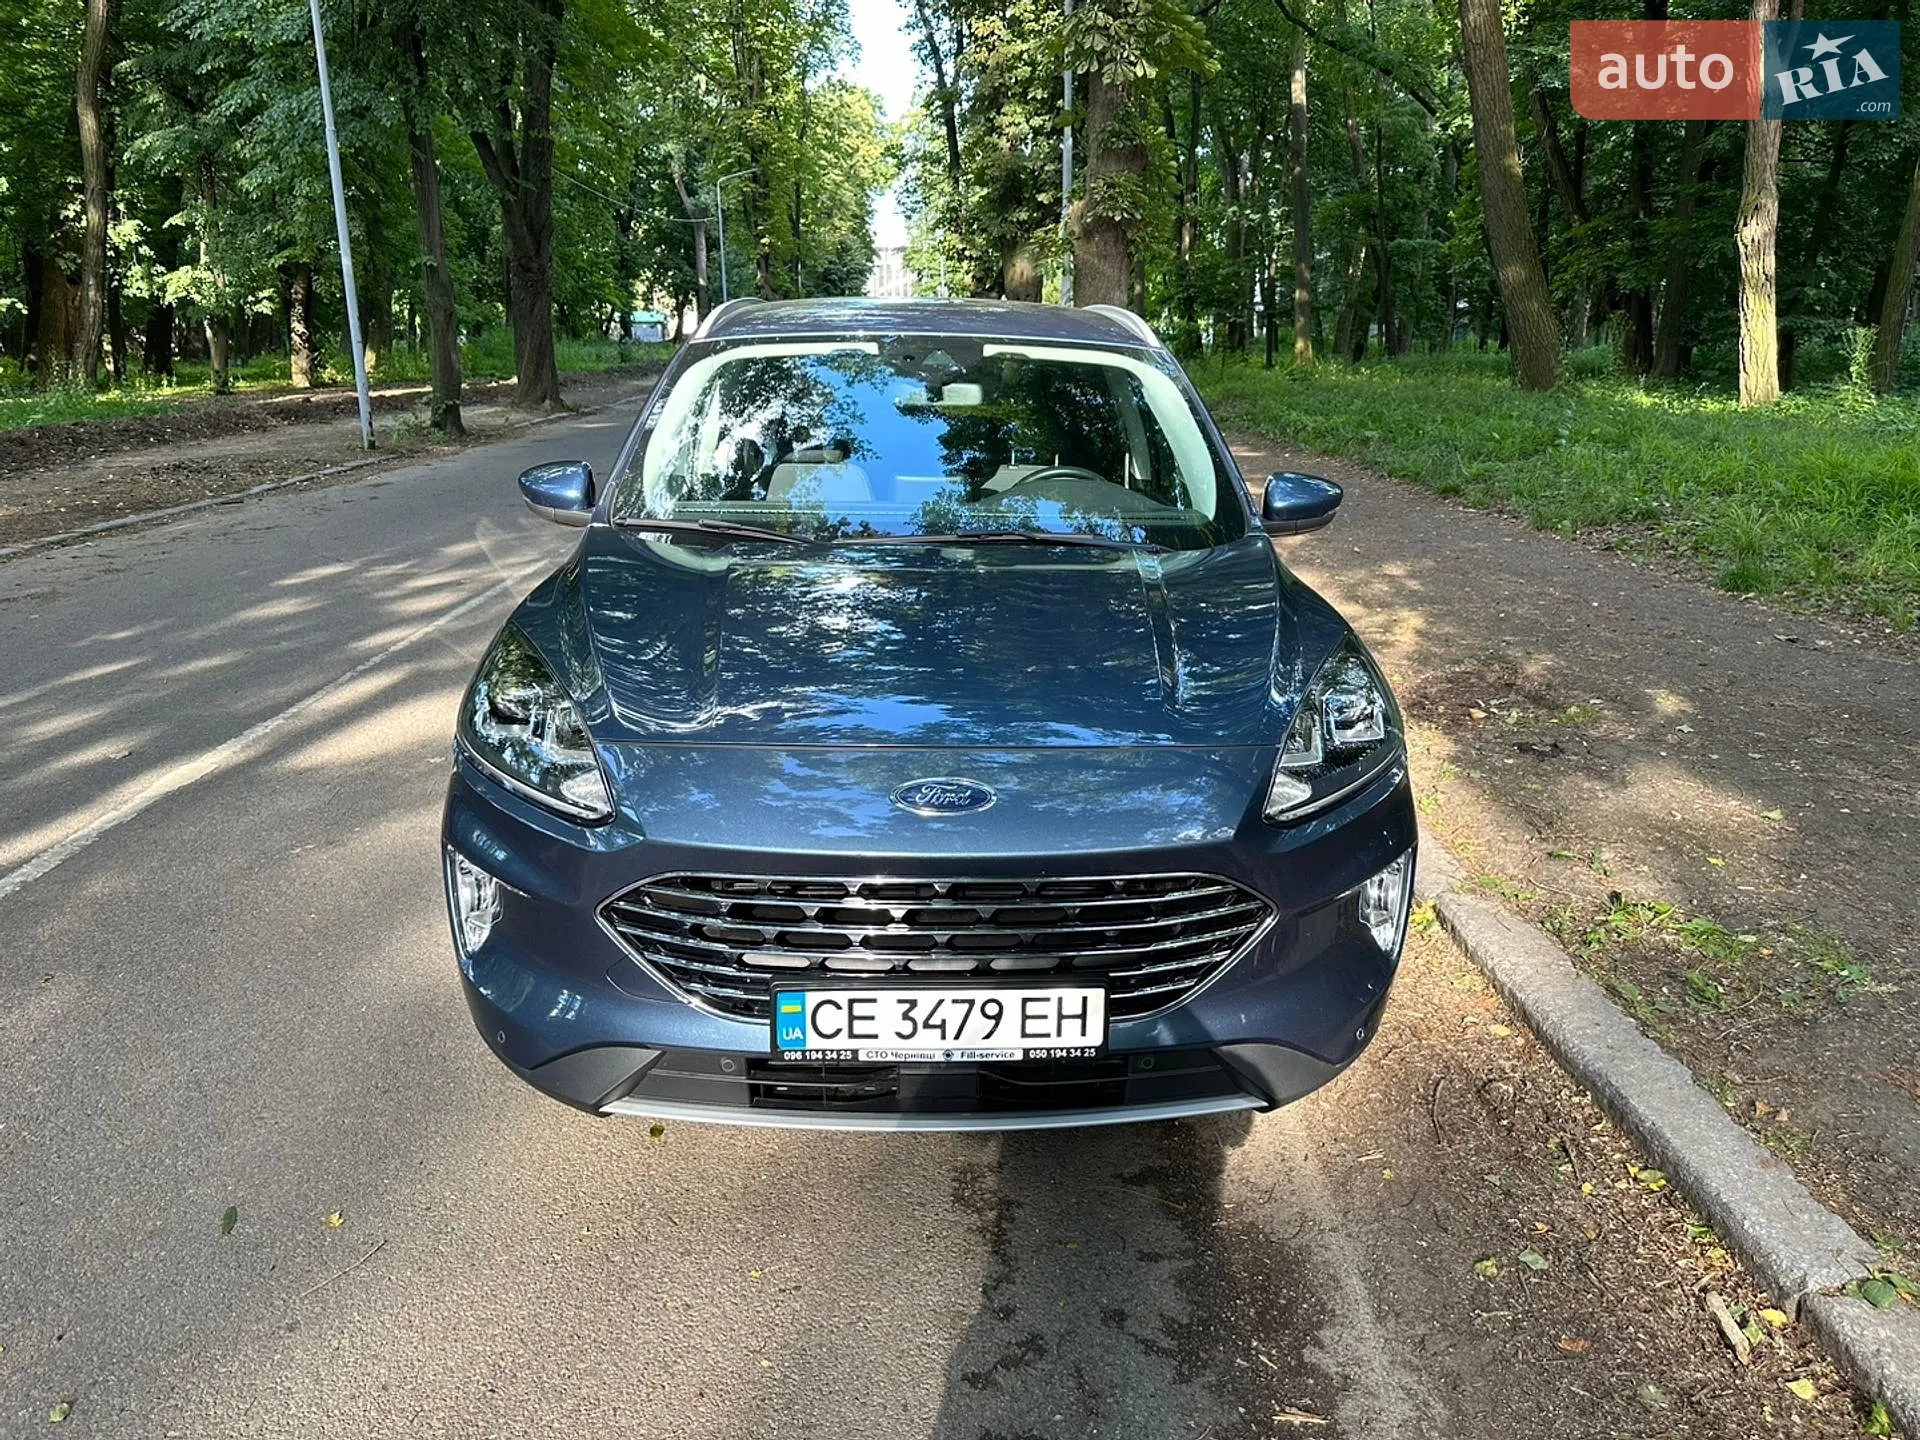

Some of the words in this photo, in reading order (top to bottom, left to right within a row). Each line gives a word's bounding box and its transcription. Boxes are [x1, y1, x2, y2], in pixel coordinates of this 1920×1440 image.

[915, 783, 972, 806] Ford
[810, 998, 879, 1040] CE
[894, 997, 1004, 1041] 3479
[1020, 996, 1088, 1039] EH
[782, 1027, 804, 1040] UA
[783, 1051, 802, 1061] 096
[805, 1050, 823, 1060] 194
[824, 1050, 838, 1060] 34
[839, 1050, 852, 1060] 25
[866, 1050, 888, 1060] СТО
[960, 1050, 1015, 1060] Fill-service
[1029, 1049, 1047, 1059] 050
[1050, 1049, 1068, 1058] 194
[1069, 1048, 1082, 1058] 34
[1083, 1048, 1096, 1057] 25
